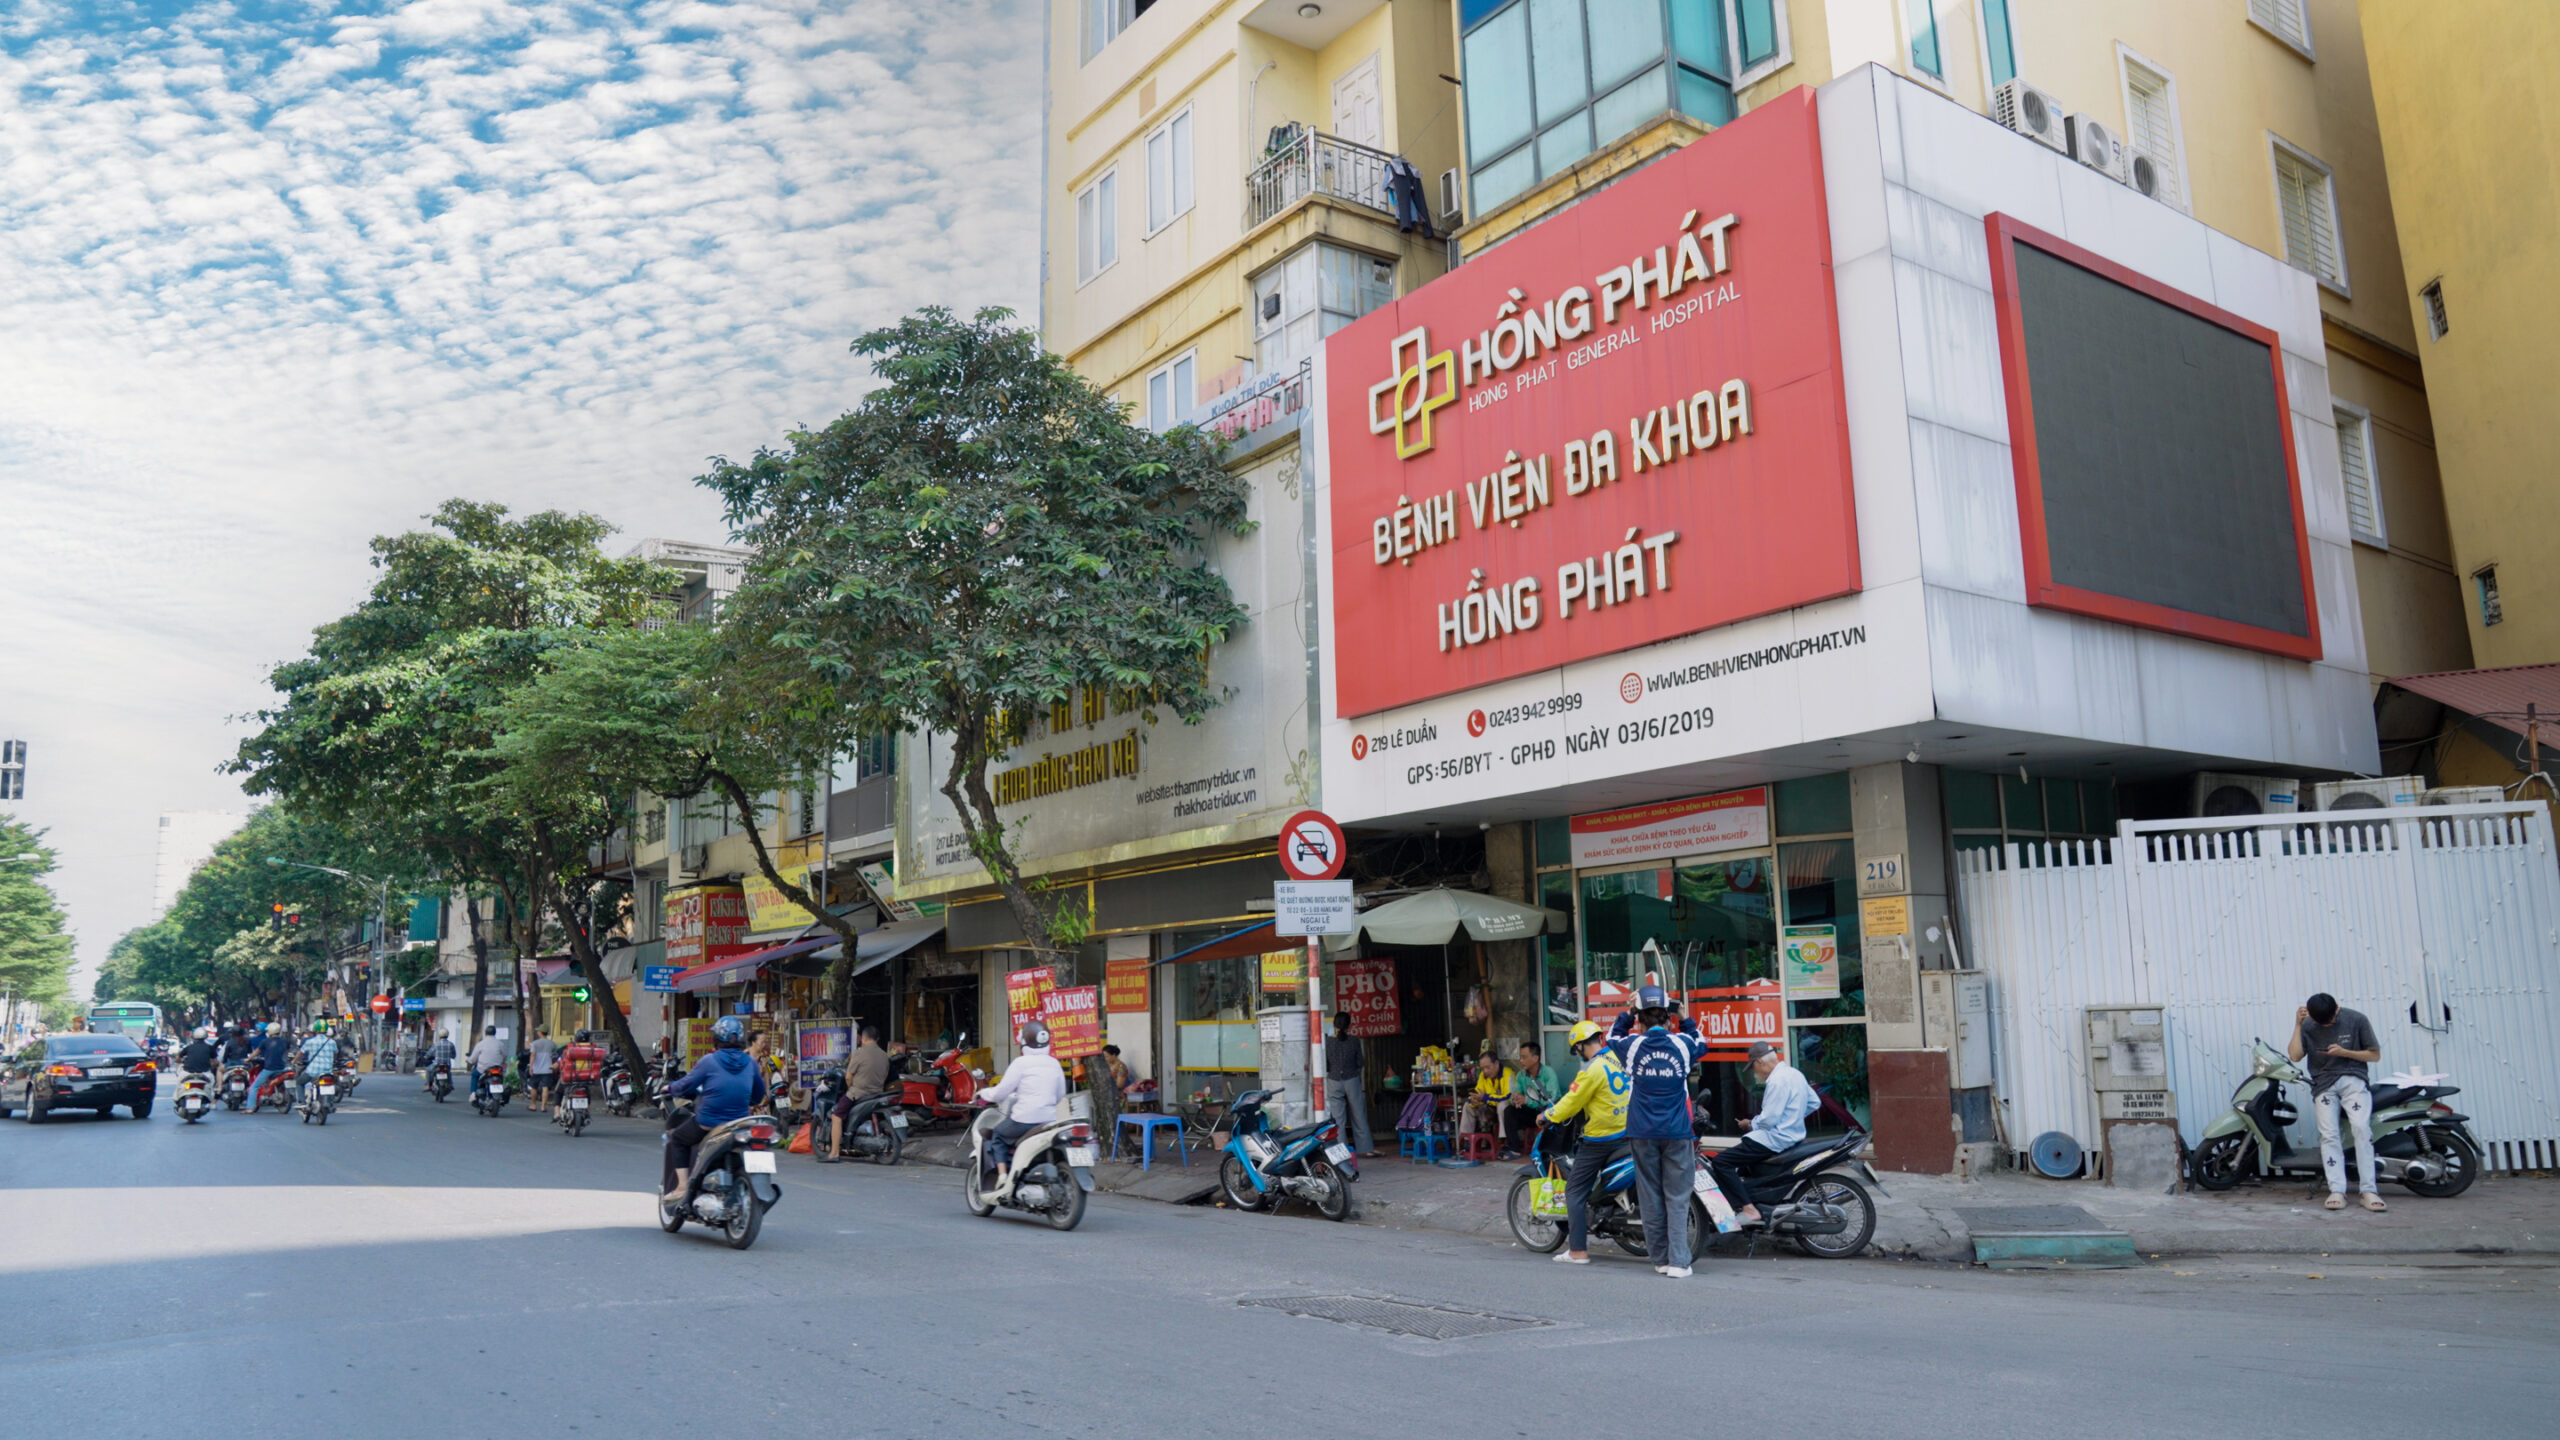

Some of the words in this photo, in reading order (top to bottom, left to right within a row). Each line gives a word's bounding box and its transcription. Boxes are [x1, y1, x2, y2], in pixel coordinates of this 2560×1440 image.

[1461, 287, 1594, 387] HỒNG
[1596, 208, 1740, 325] PHÁT
[1468, 381, 1508, 413] HONG
[1516, 359, 1558, 393] PHAT
[1567, 324, 1640, 372] GENERAL
[1651, 281, 1741, 335] HOSPITAL
[1374, 490, 1459, 568] BỆNH
[1467, 450, 1552, 528] VIỆN
[1564, 428, 1620, 495] ĐA
[1630, 378, 1754, 473] KHOA
[1438, 567, 1542, 652] HỒNG
[1558, 527, 1679, 619] PHÁT
[1647, 625, 1866, 693] WWW.BENHVIENHONGPHAT.VN
[1489, 705, 1519, 729] 0243
[1520, 699, 1546, 722] 942
[1547, 693, 1582, 717] 9999
[1371, 734, 1388, 753] 219
[1391, 728, 1403, 748] LÊ
[1406, 718, 1437, 746] DUẨN
[1407, 752, 1492, 785] GPS:56/BYT
[1511, 740, 1556, 766] GPHĐ
[1566, 724, 1610, 755] NGÀY
[1618, 707, 1715, 745] 03/6/2019
[1031, 753, 1073, 798] RĂNG
[1865, 860, 1897, 881] 219
[1337, 966, 1396, 996] PHỞ
[1044, 991, 1064, 1014] XÔI
[1065, 988, 1095, 1012] KHÚC
[1368, 1012, 1394, 1023] CHÍN
[1367, 1024, 1396, 1035] VANG
[1711, 1004, 1740, 1035] ĐẨY
[1744, 1008, 1776, 1035] VÀO
